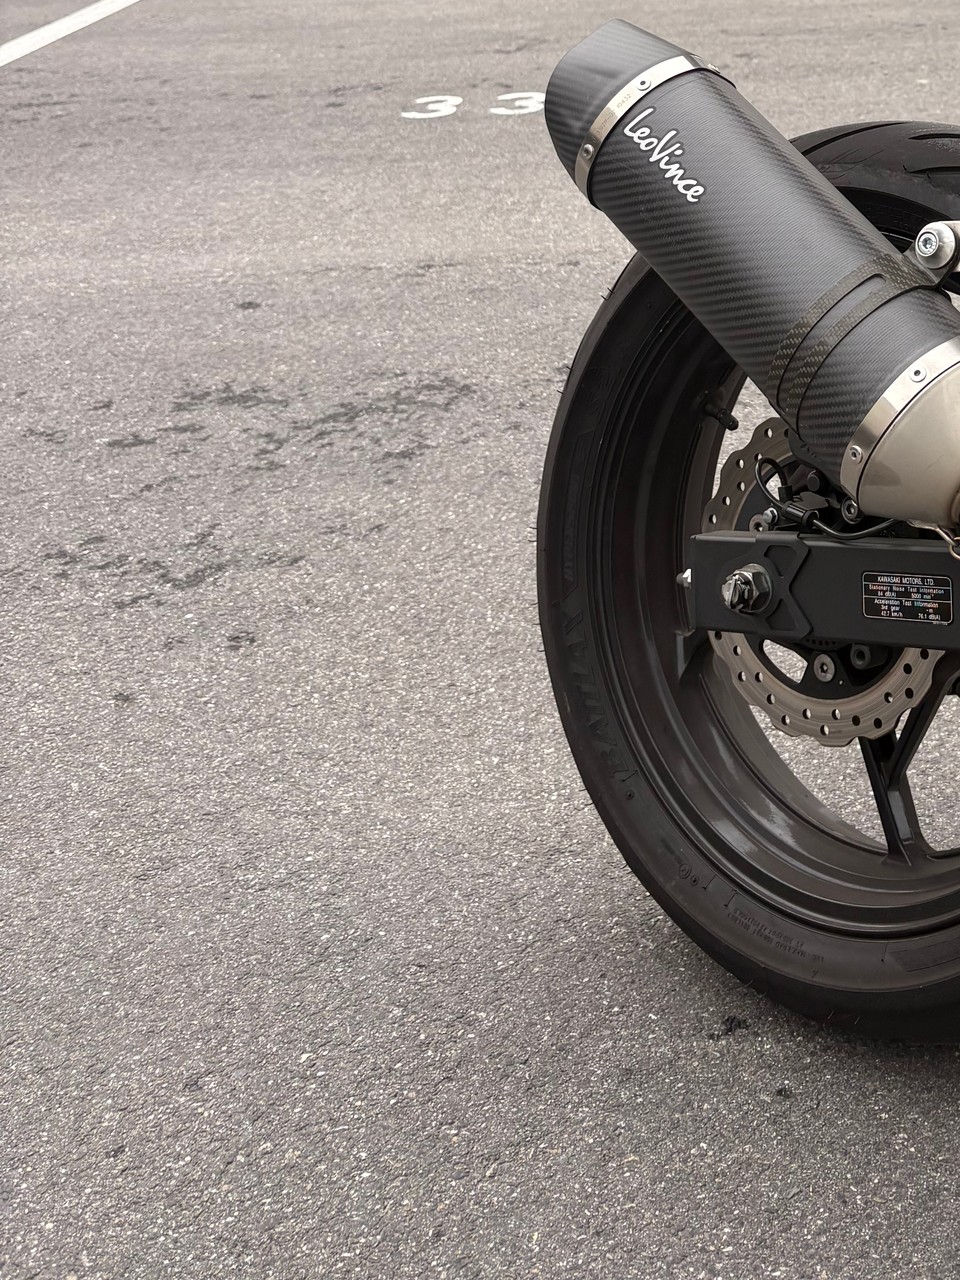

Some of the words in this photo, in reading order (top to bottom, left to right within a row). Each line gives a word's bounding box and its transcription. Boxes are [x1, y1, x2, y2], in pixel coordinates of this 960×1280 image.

[401, 92, 546, 119] 33
[623, 107, 705, 203] LeoVince
[869, 584, 890, 592] Stationary
